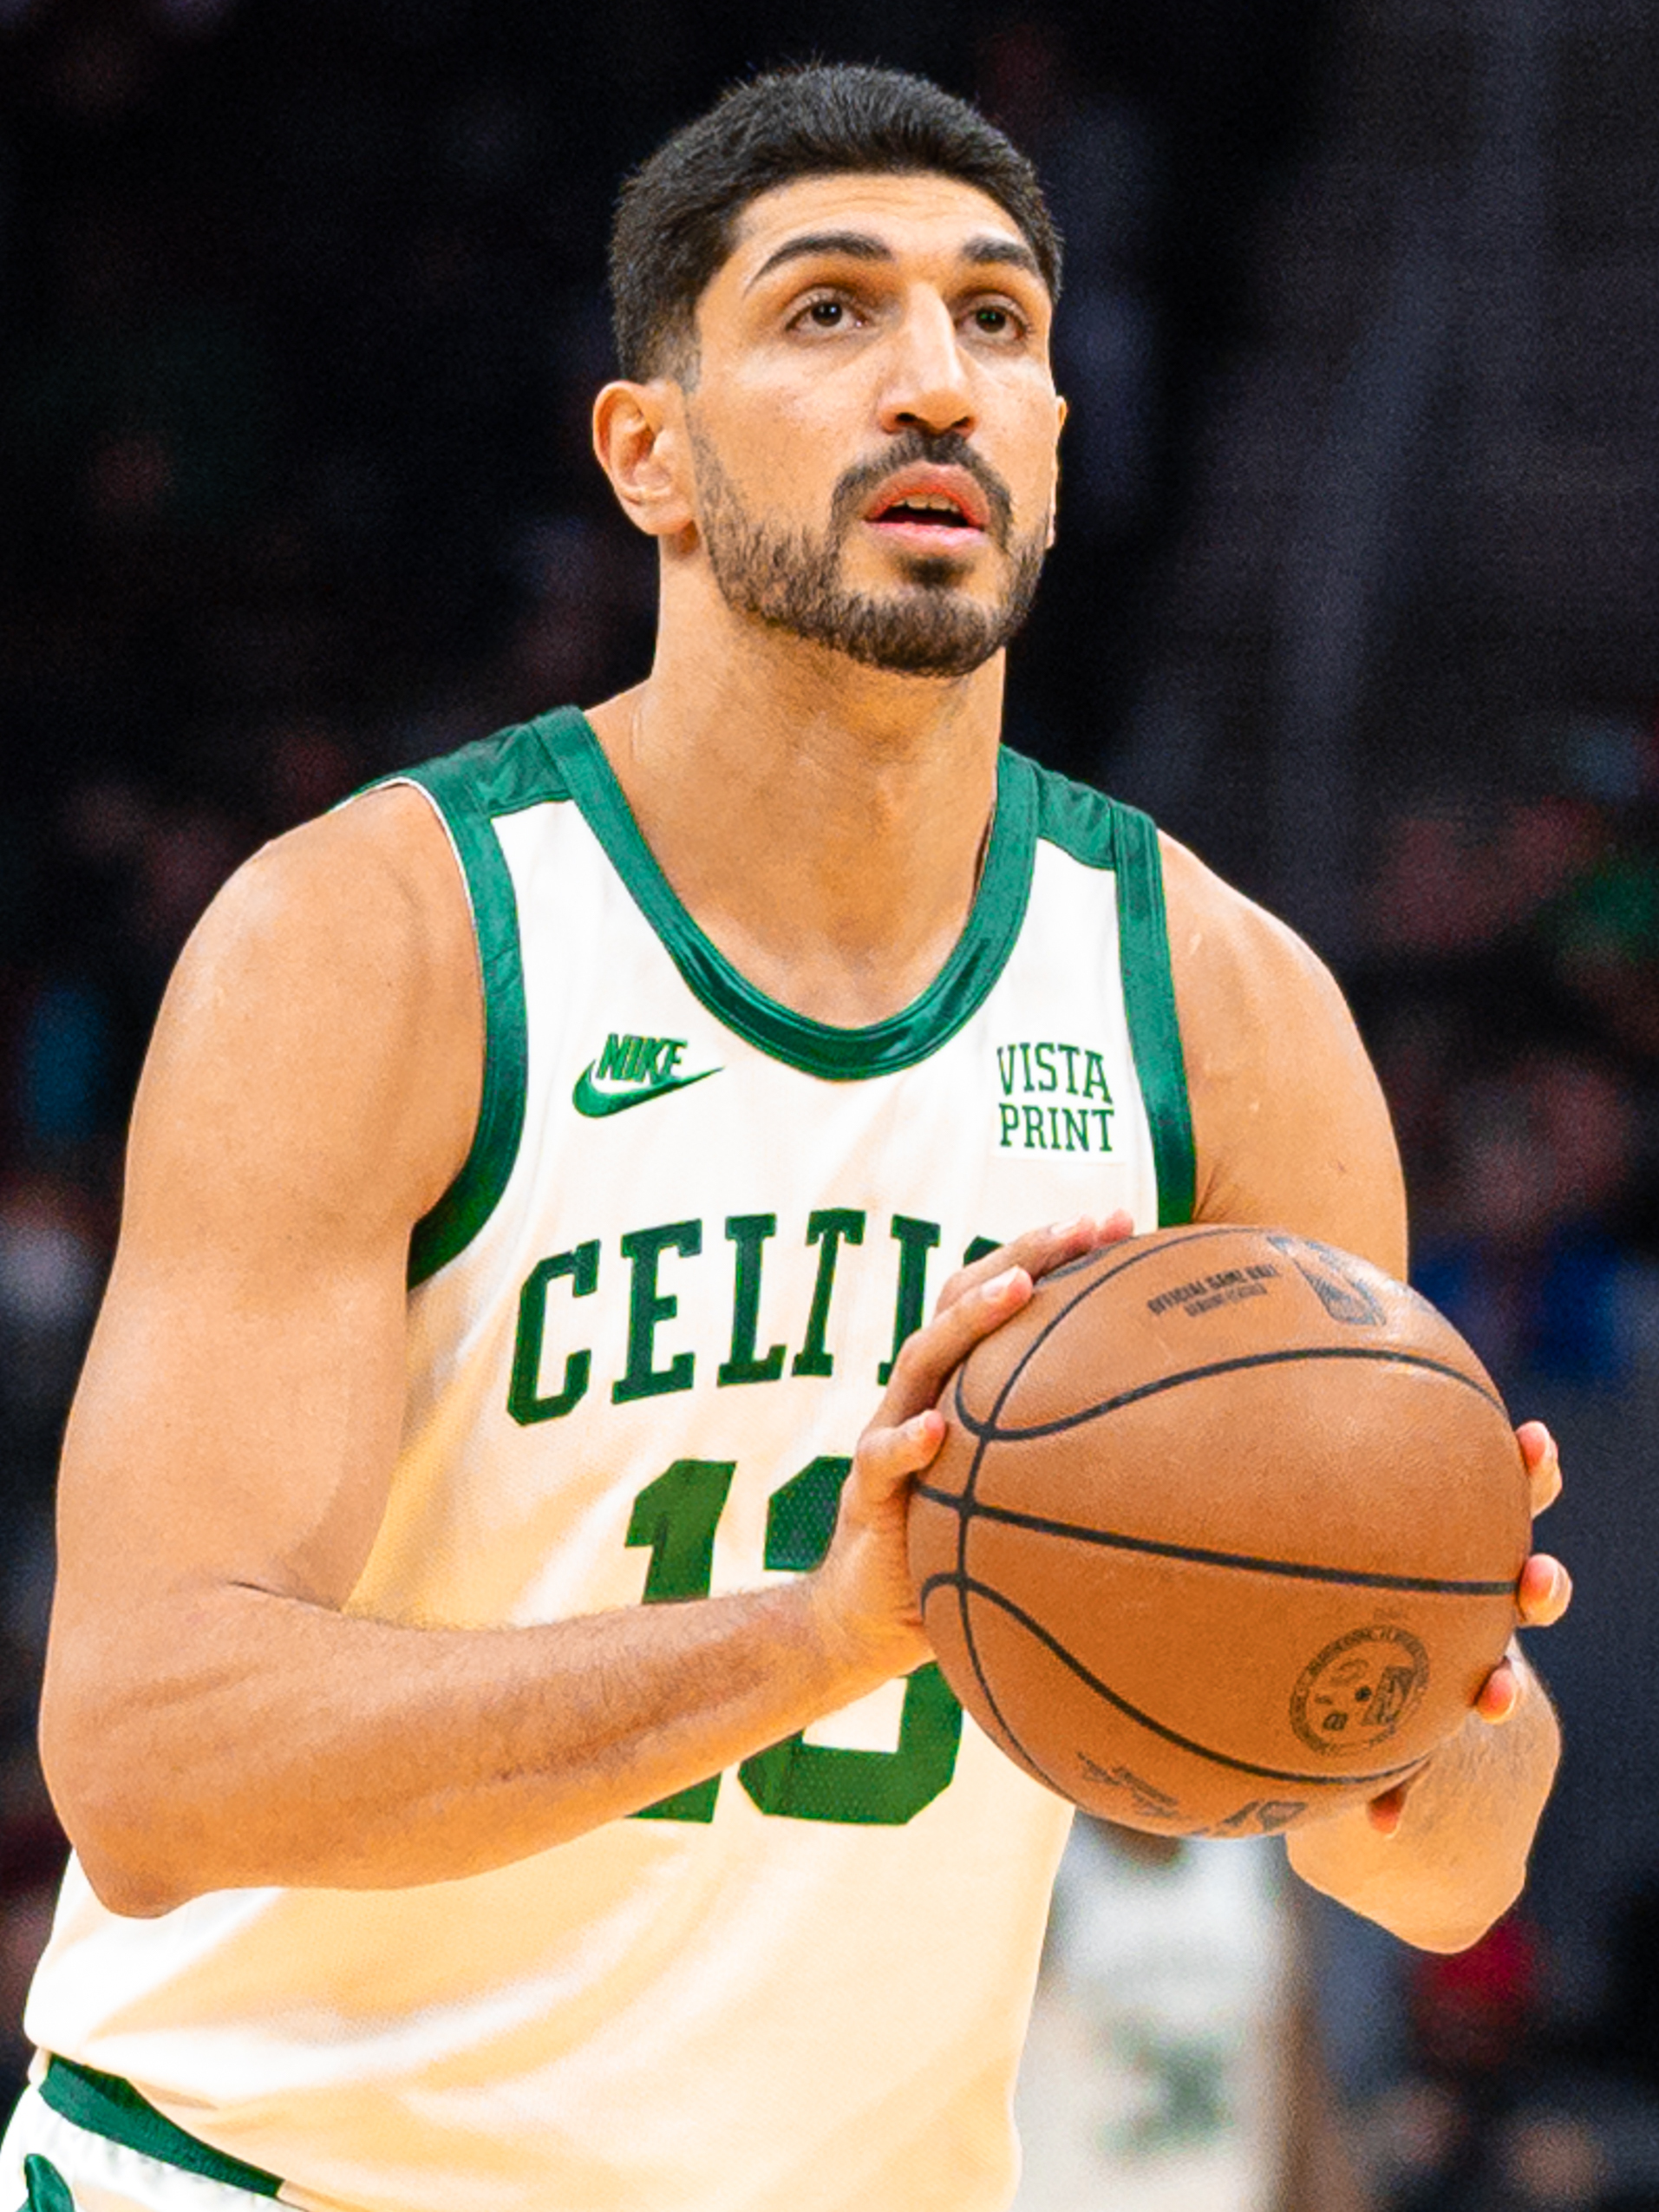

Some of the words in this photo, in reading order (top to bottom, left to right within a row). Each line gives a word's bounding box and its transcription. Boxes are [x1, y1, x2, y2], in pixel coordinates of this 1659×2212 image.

[596, 1032, 688, 1084] NIKE
[996, 1042, 1114, 1104] VISTA
[998, 1103, 1115, 1153] PRINT
[506, 1207, 1003, 1426] CELTI
